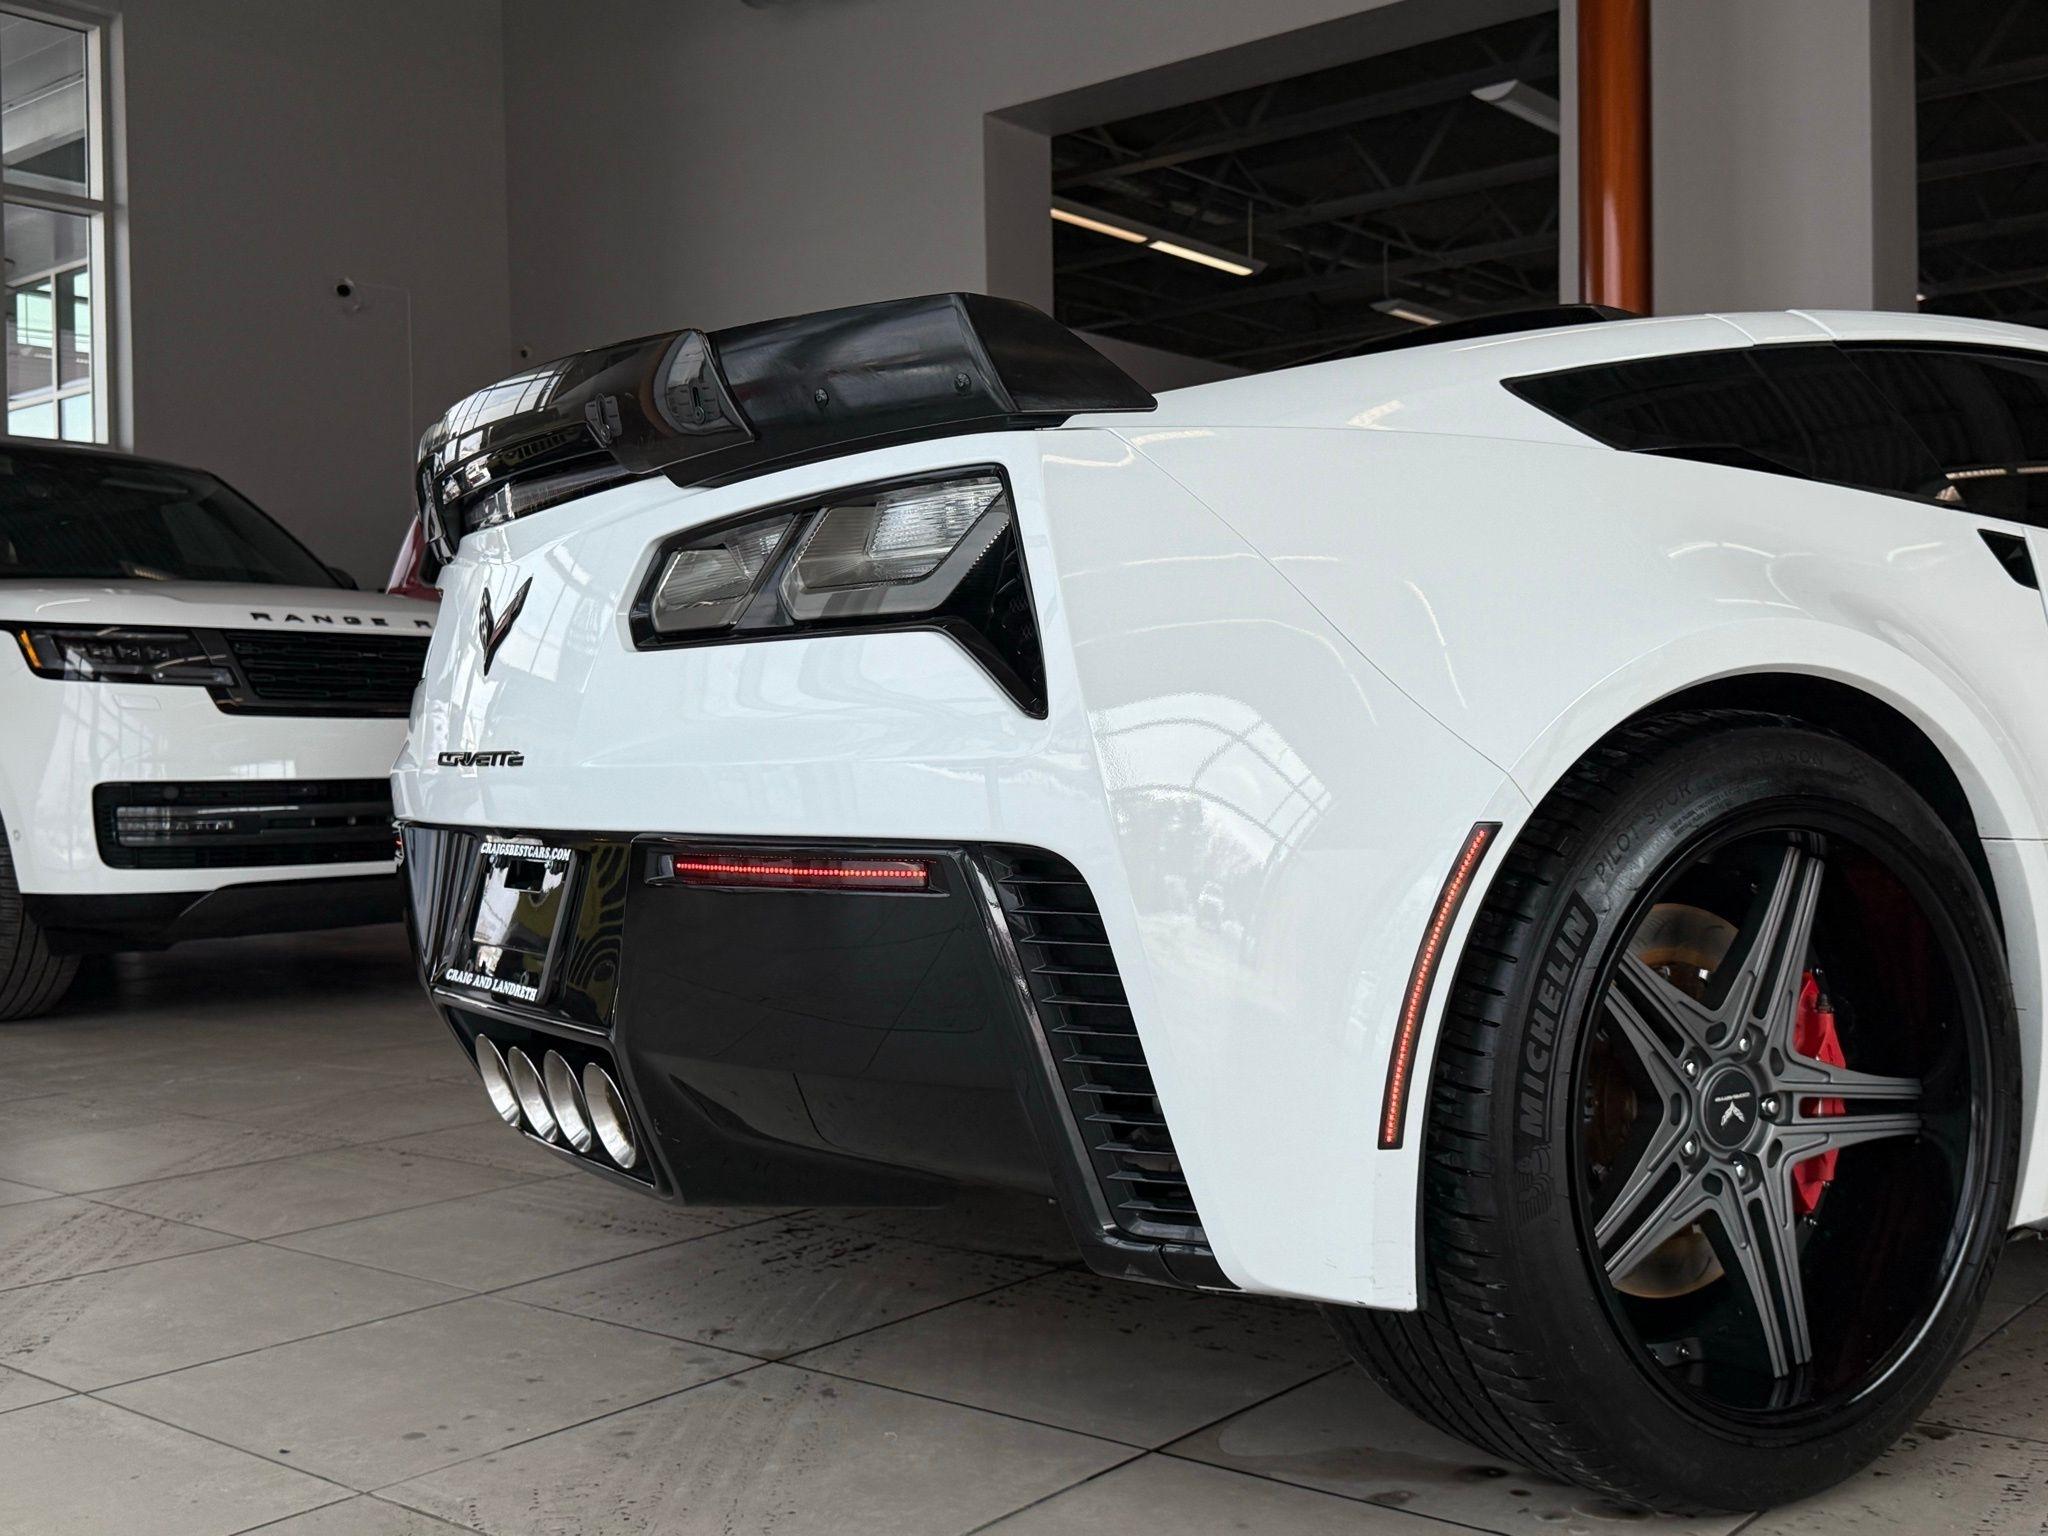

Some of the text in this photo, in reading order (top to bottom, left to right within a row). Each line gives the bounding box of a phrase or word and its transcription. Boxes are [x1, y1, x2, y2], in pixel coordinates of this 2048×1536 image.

[250, 612, 390, 627] RANGE
[437, 750, 525, 767] CORVETTE
[1594, 782, 1692, 884] PILOT SPOR
[480, 842, 572, 861] CRAIGSBESTCARS.COM
[445, 968, 538, 1002] CRAIG AND LANDRETH
[1519, 905, 1591, 1138] MICHELIN
